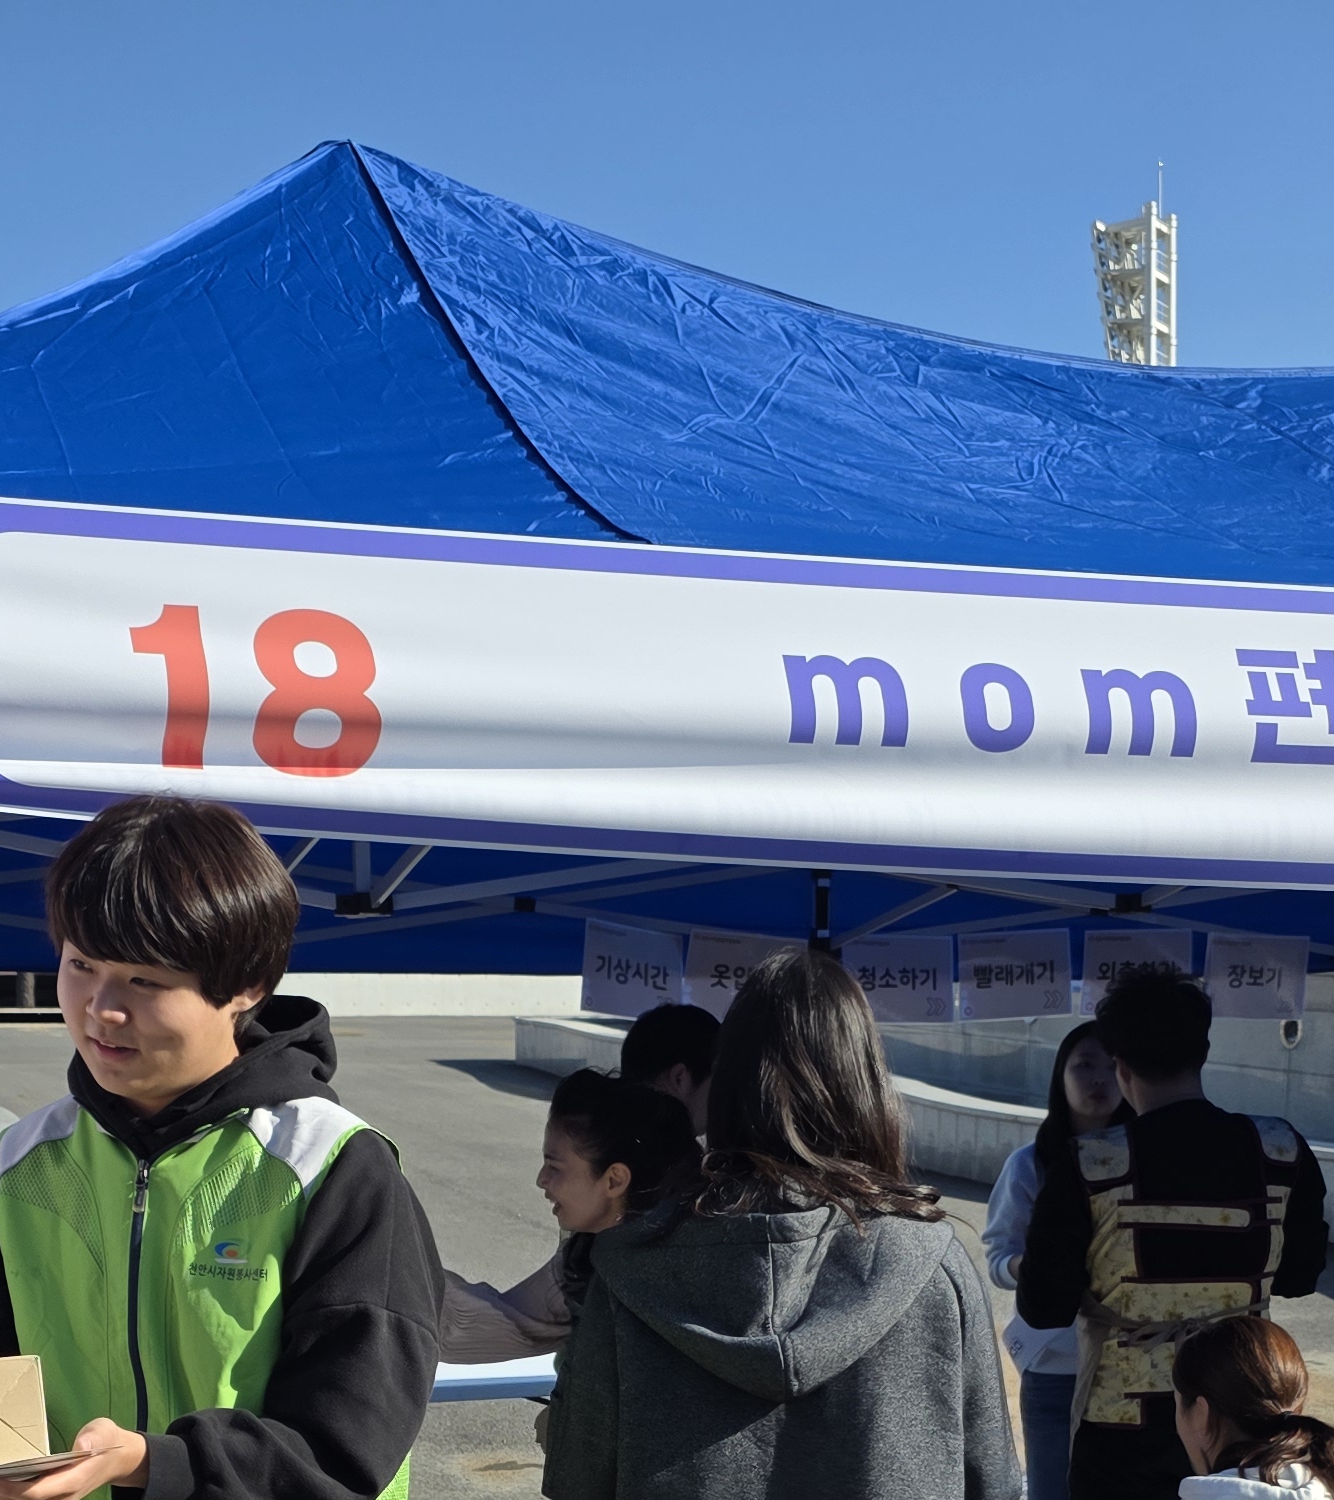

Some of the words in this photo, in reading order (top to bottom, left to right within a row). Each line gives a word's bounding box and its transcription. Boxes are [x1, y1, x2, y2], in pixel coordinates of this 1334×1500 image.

[129, 603, 383, 779] 18
[595, 955, 669, 991] 기상시간
[857, 965, 938, 992] 청소하기
[972, 959, 1055, 990] 빨래개기
[1227, 963, 1281, 992] 장보기
[188, 1262, 268, 1282] 천안시자원봉사센터
